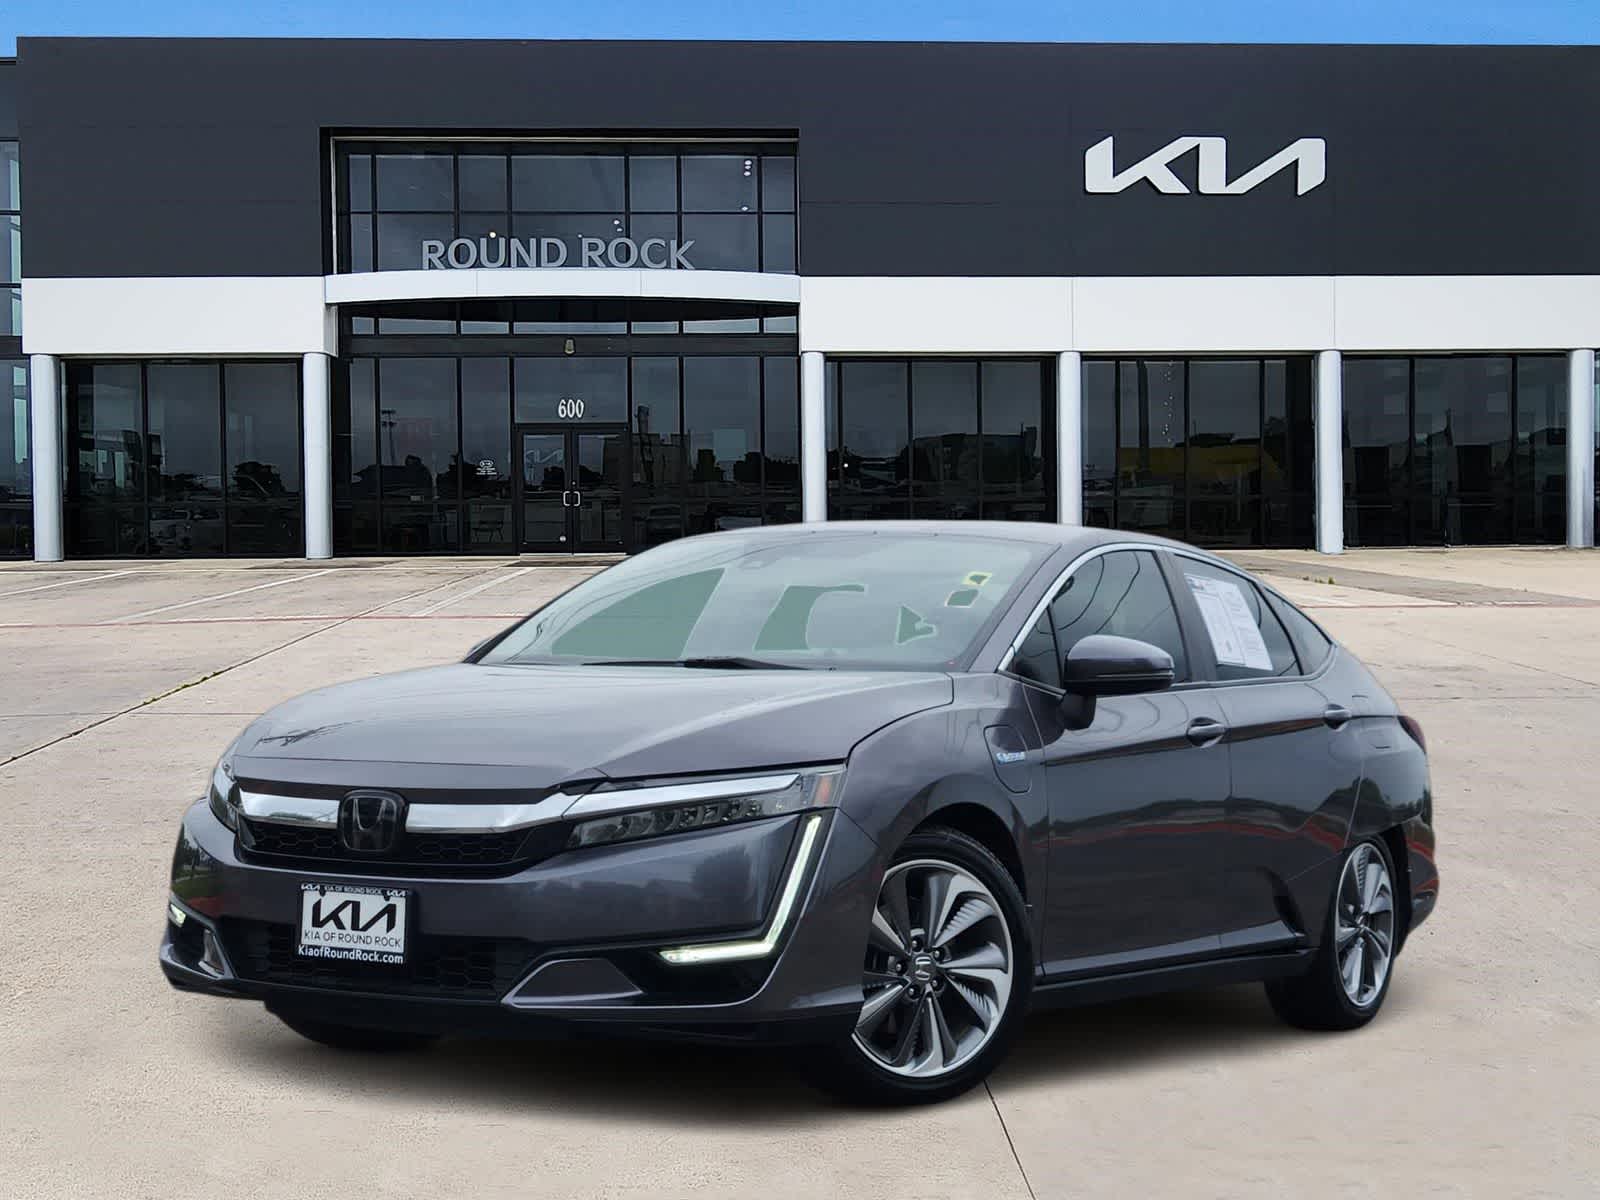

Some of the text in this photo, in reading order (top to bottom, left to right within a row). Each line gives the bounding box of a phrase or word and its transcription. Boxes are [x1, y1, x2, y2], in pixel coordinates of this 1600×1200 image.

[1085, 135, 1326, 196] KIA
[422, 237, 695, 269] ROUND ROCK
[558, 399, 584, 418] 600
[312, 898, 397, 934] KIA
[304, 930, 401, 948] KIA OF ROUND ROCK
[298, 945, 404, 964] KiaofRoundRock.com
